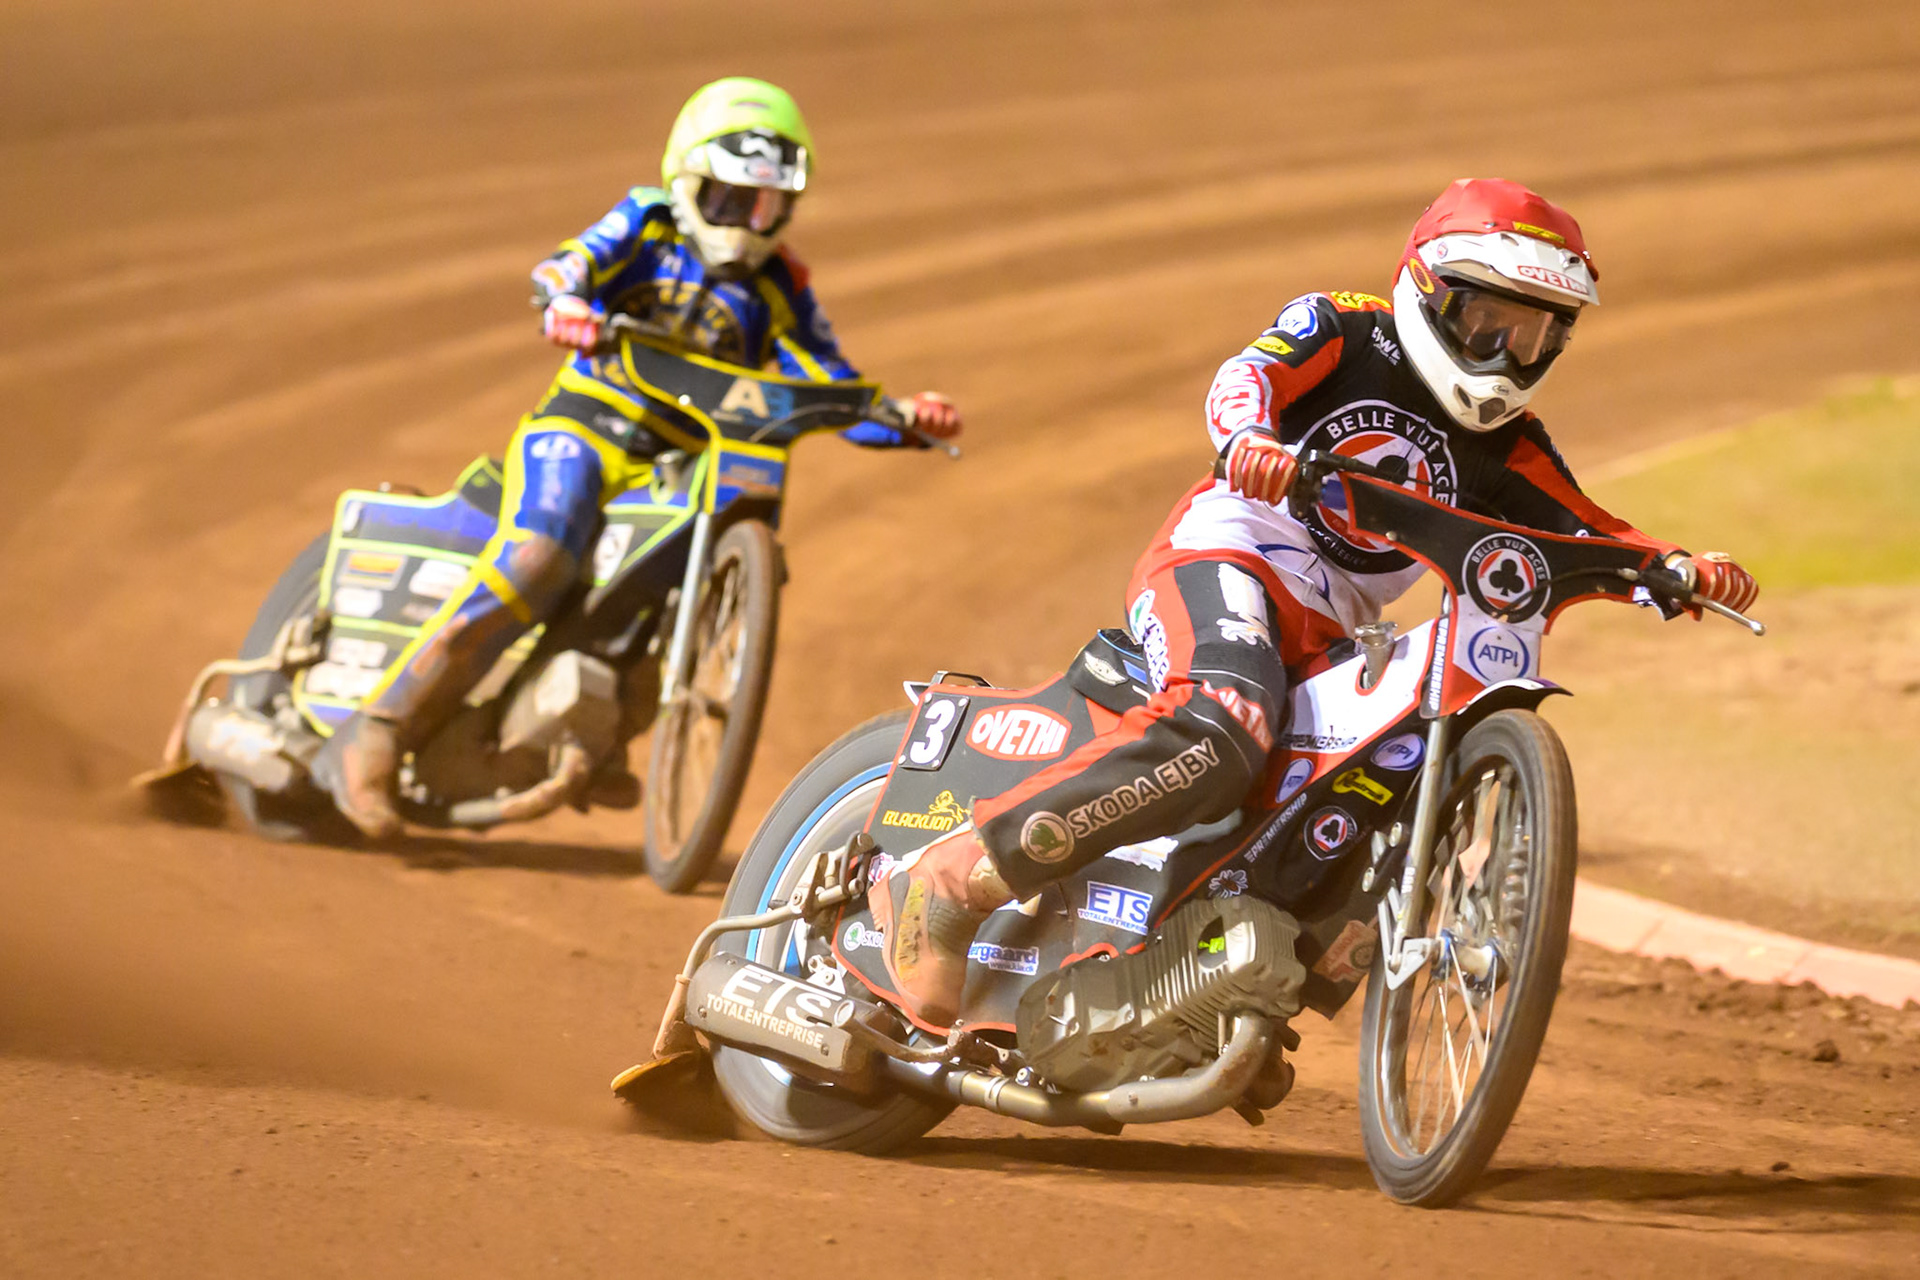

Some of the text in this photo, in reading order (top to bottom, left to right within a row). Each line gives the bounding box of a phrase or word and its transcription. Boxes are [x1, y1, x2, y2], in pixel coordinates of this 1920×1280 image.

[1326, 410, 1450, 504] BELLE VUE ACE
[1471, 538, 1547, 581] BELLE VUE ACES
[1477, 643, 1519, 667] ATPI
[910, 699, 956, 764] 3
[971, 709, 1068, 756] OVETHI
[1067, 737, 1220, 838] SKODA EJBY
[883, 810, 954, 832] BLACKLION
[1088, 883, 1151, 923] ETS
[862, 930, 884, 946] SKO
[722, 964, 842, 1028] ETS
[707, 993, 824, 1048] TOTALENTREPRISE
